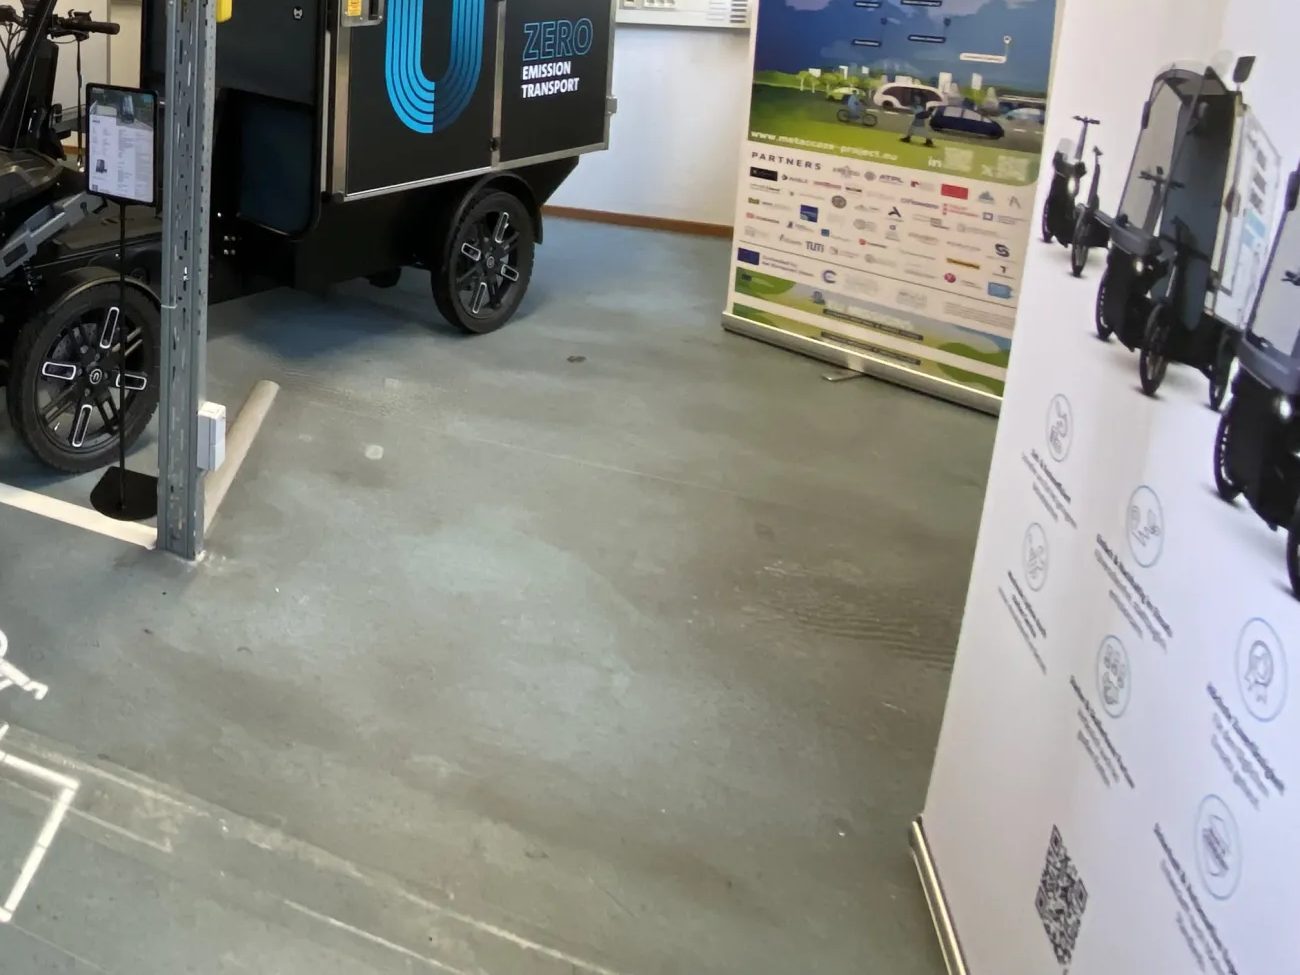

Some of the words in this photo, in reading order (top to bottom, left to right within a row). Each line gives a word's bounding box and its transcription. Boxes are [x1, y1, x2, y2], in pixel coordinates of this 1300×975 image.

[523, 17, 594, 61] ZERO
[523, 61, 571, 80] EMISSION
[521, 78, 580, 98] TRANSPORT
[751, 152, 822, 171] PARTNERS
